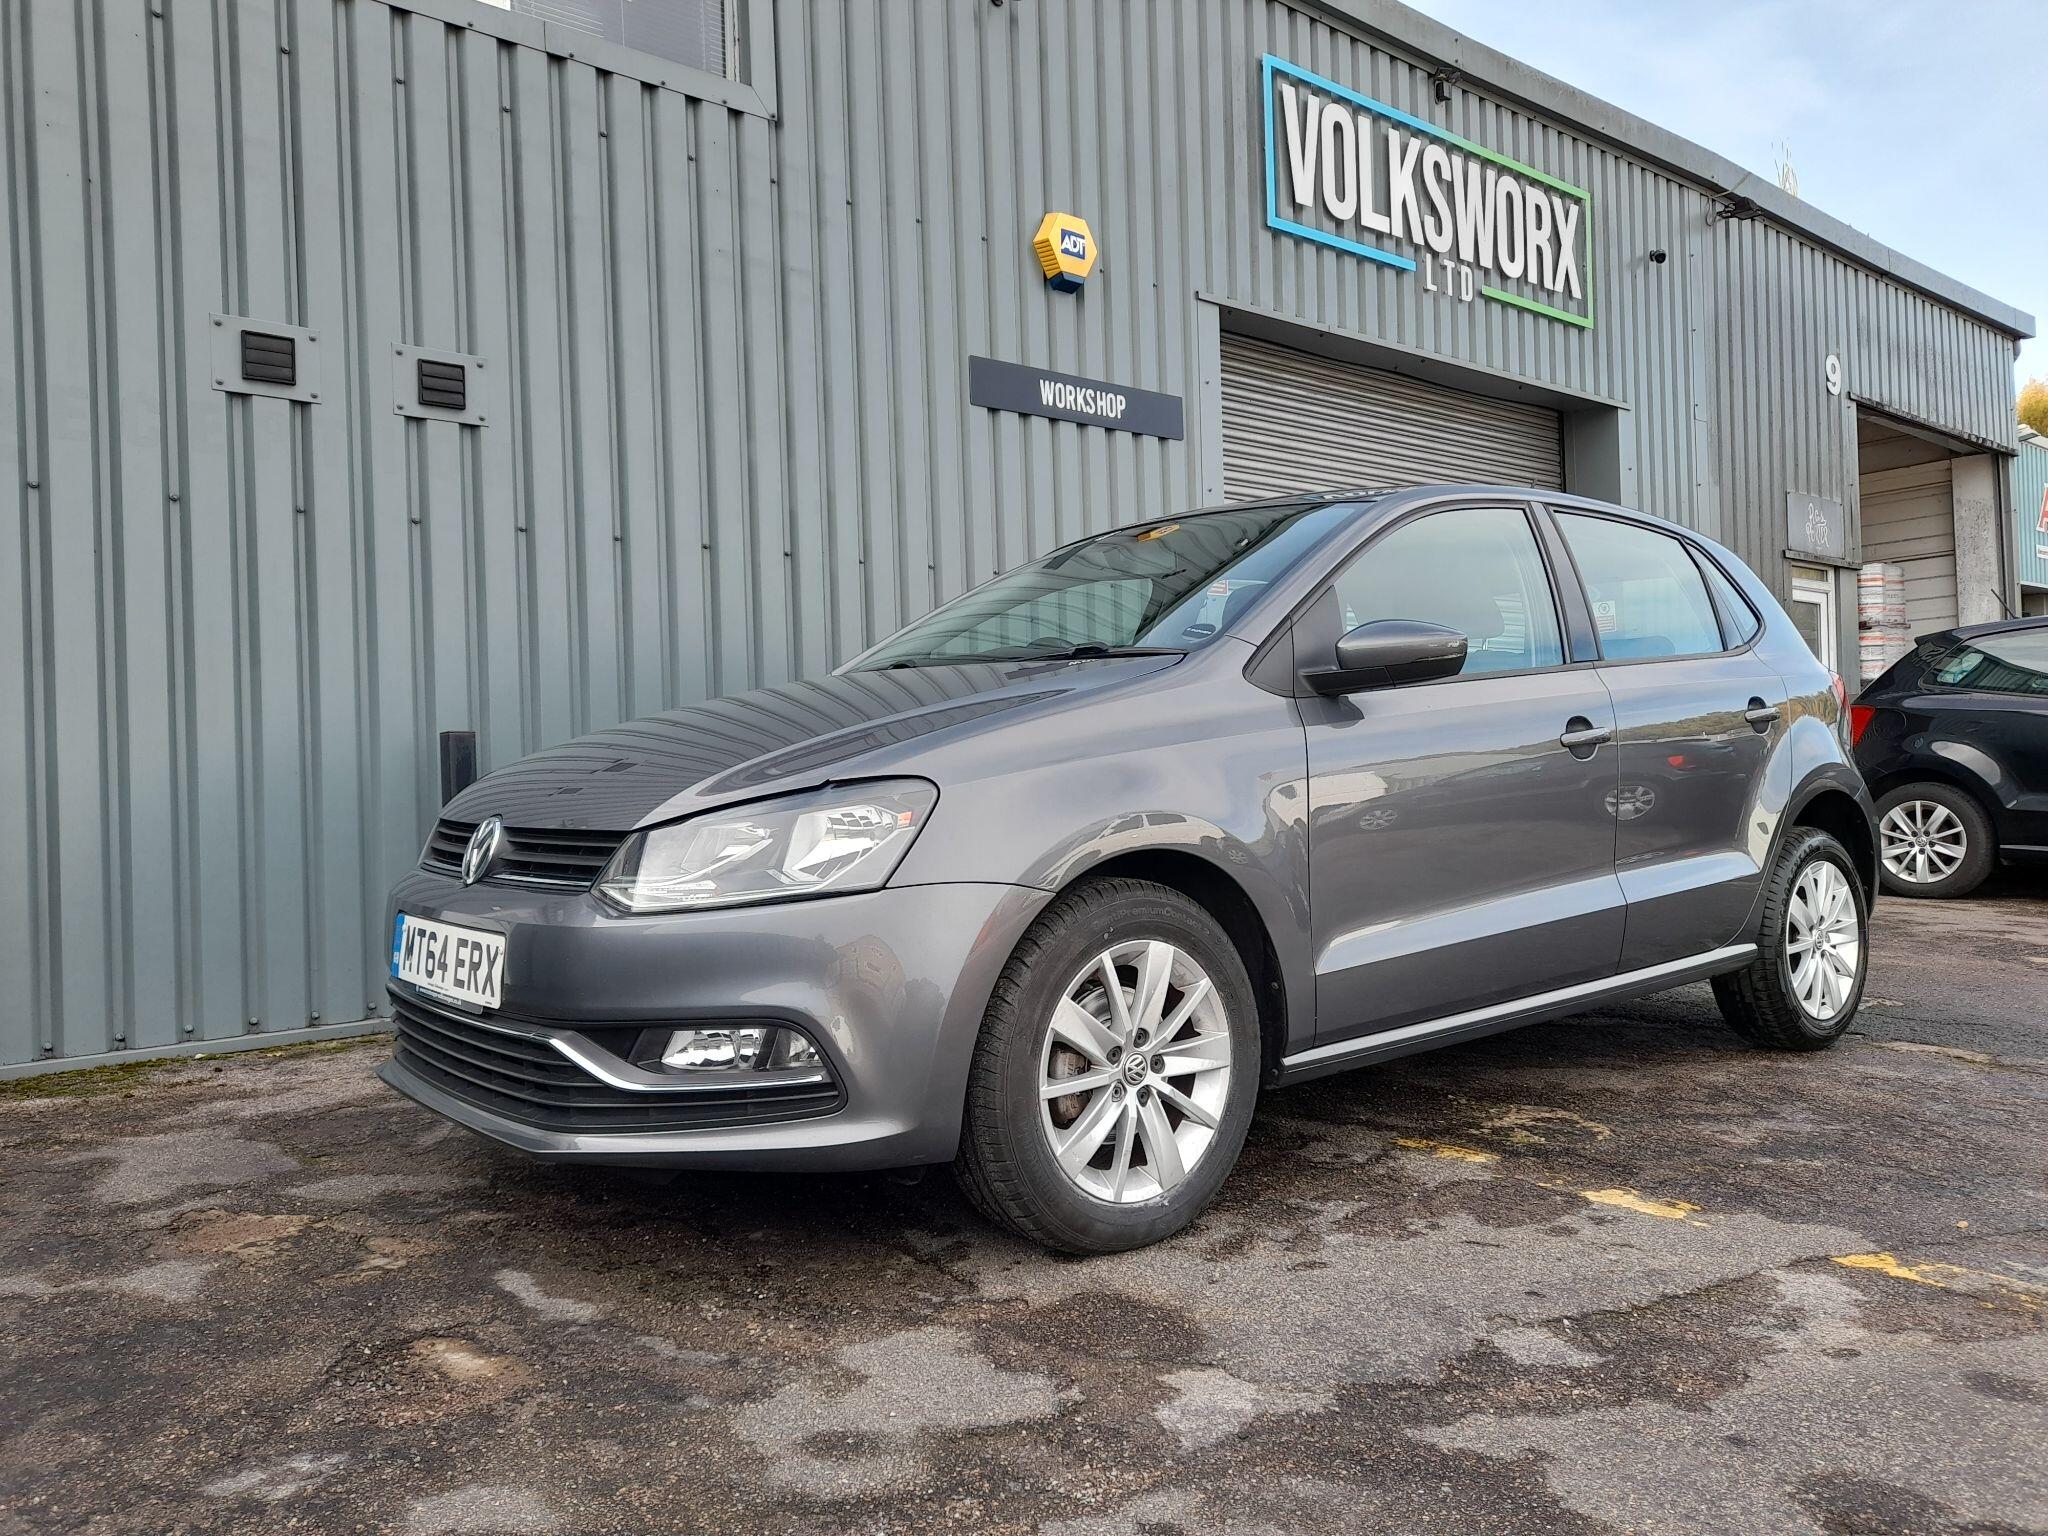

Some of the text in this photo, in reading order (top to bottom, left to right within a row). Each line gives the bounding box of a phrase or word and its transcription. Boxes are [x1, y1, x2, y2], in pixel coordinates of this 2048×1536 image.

[1281, 82, 1582, 300] VOLKSWORX
[1060, 233, 1085, 256] ADT
[1425, 253, 1474, 302] LTD
[1825, 354, 1842, 396] 9
[1039, 378, 1127, 419] WORKSHOP
[402, 925, 500, 998] MT64 ERX
